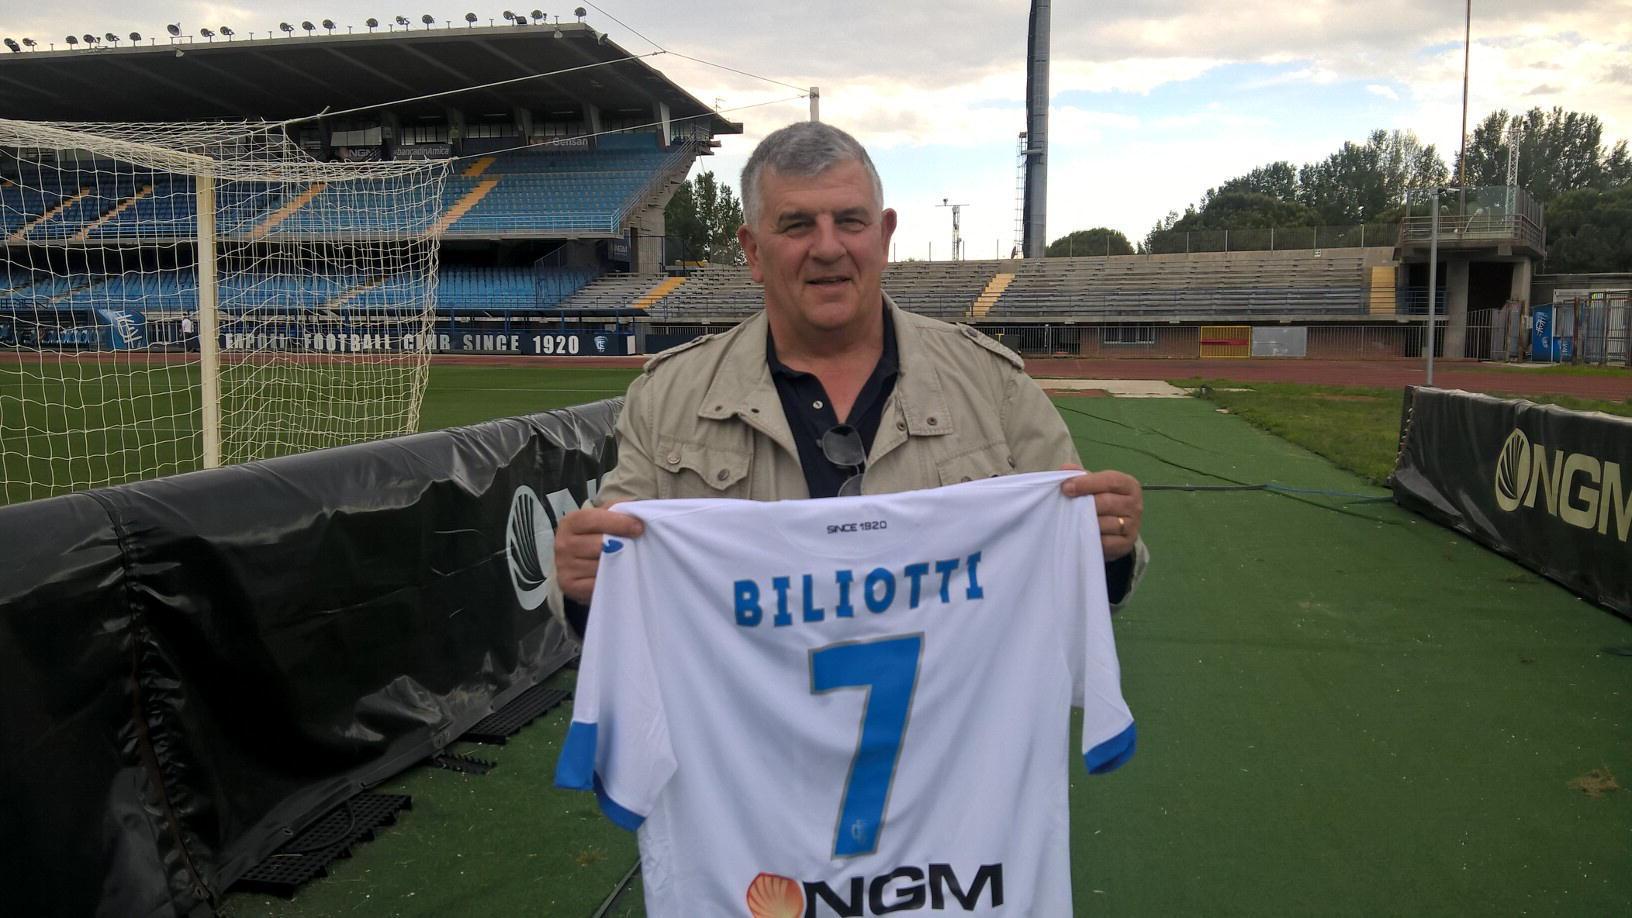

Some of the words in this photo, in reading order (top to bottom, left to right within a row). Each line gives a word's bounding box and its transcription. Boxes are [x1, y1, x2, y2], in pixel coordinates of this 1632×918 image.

[463, 334, 519, 351] SINCE
[533, 335, 580, 354] 1920
[1523, 443, 1632, 542] NGM
[827, 523, 857, 534] SINCE
[860, 521, 887, 531] 1920
[734, 551, 984, 627] BILIOTTI
[808, 631, 925, 861] 7
[802, 863, 1004, 918] NGM
